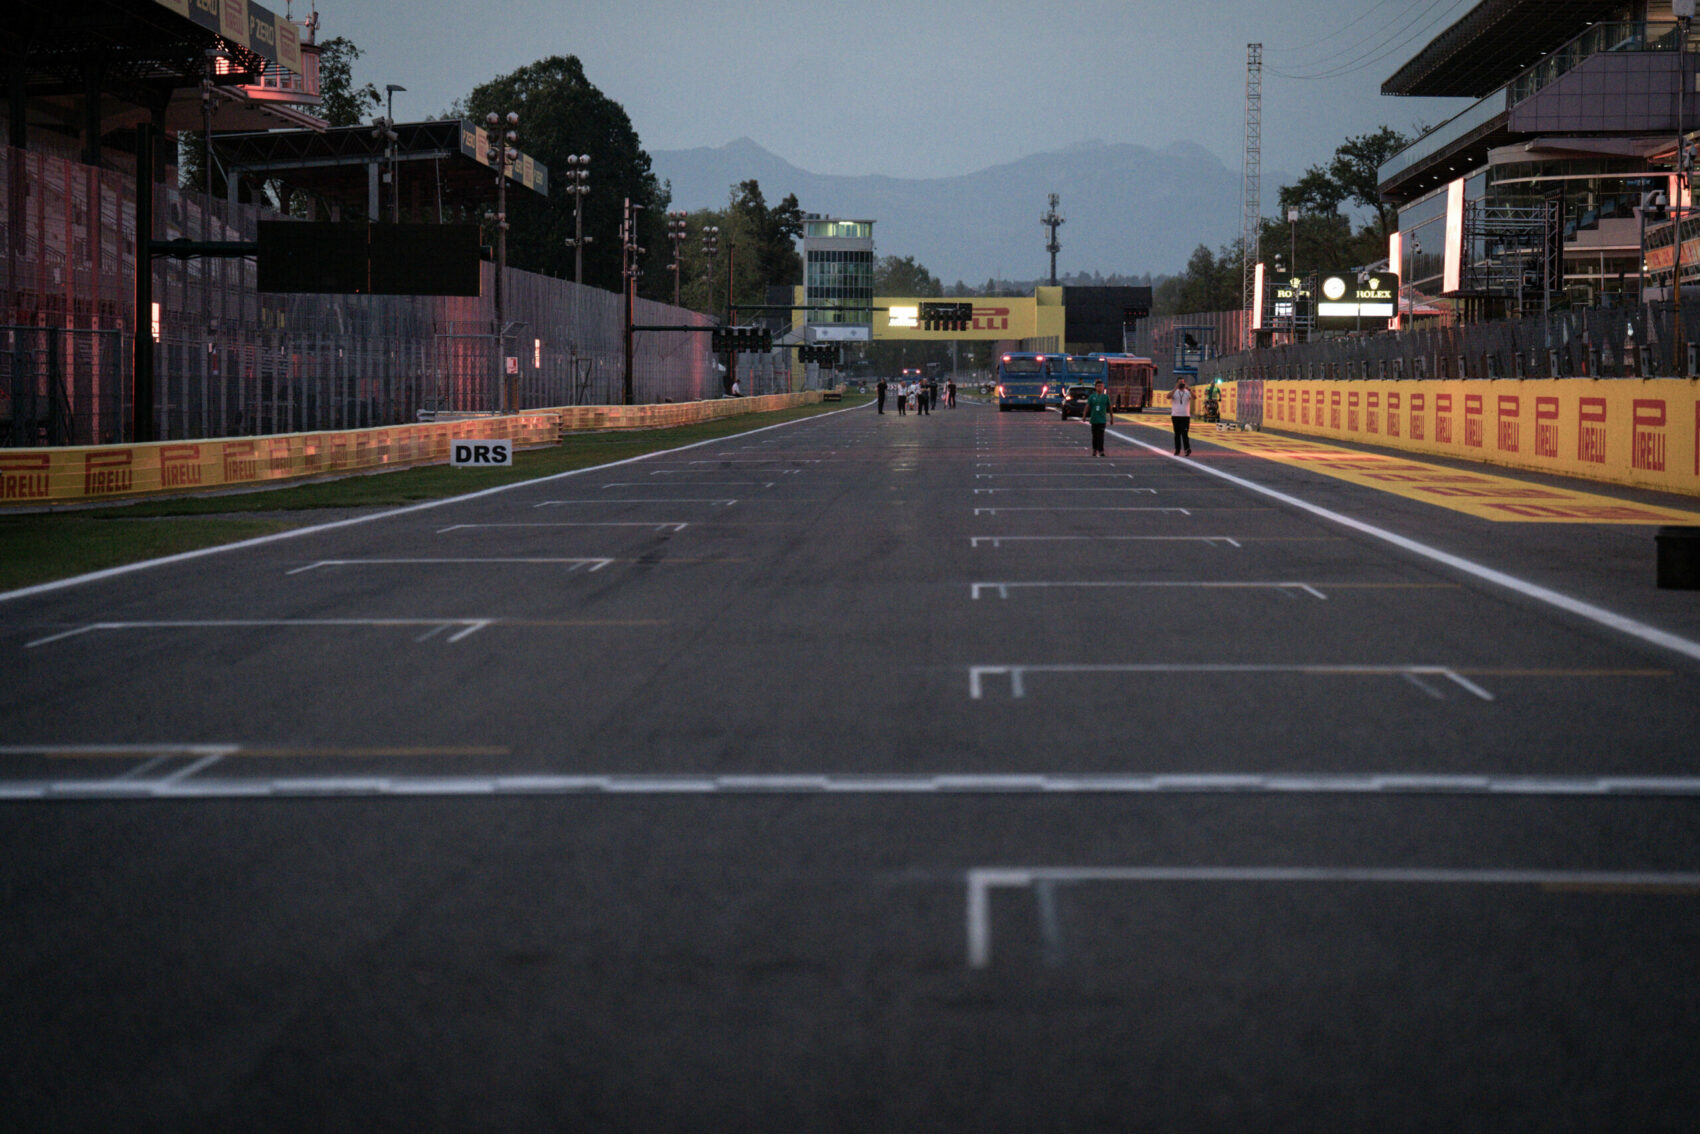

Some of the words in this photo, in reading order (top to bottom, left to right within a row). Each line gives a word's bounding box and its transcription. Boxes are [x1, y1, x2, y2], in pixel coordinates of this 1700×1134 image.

[1356, 290, 1392, 299] ROLEX
[1464, 394, 1483, 448] PIRELLI
[1497, 395, 1520, 453] PIRELLI
[1535, 396, 1558, 458] PIRELLI
[1577, 397, 1606, 464] PIRELLI
[1632, 398, 1666, 472] PIRELLI
[84, 449, 133, 495] PIRELLI
[159, 444, 201, 487] PIRELLI
[455, 445, 507, 463] DRS
